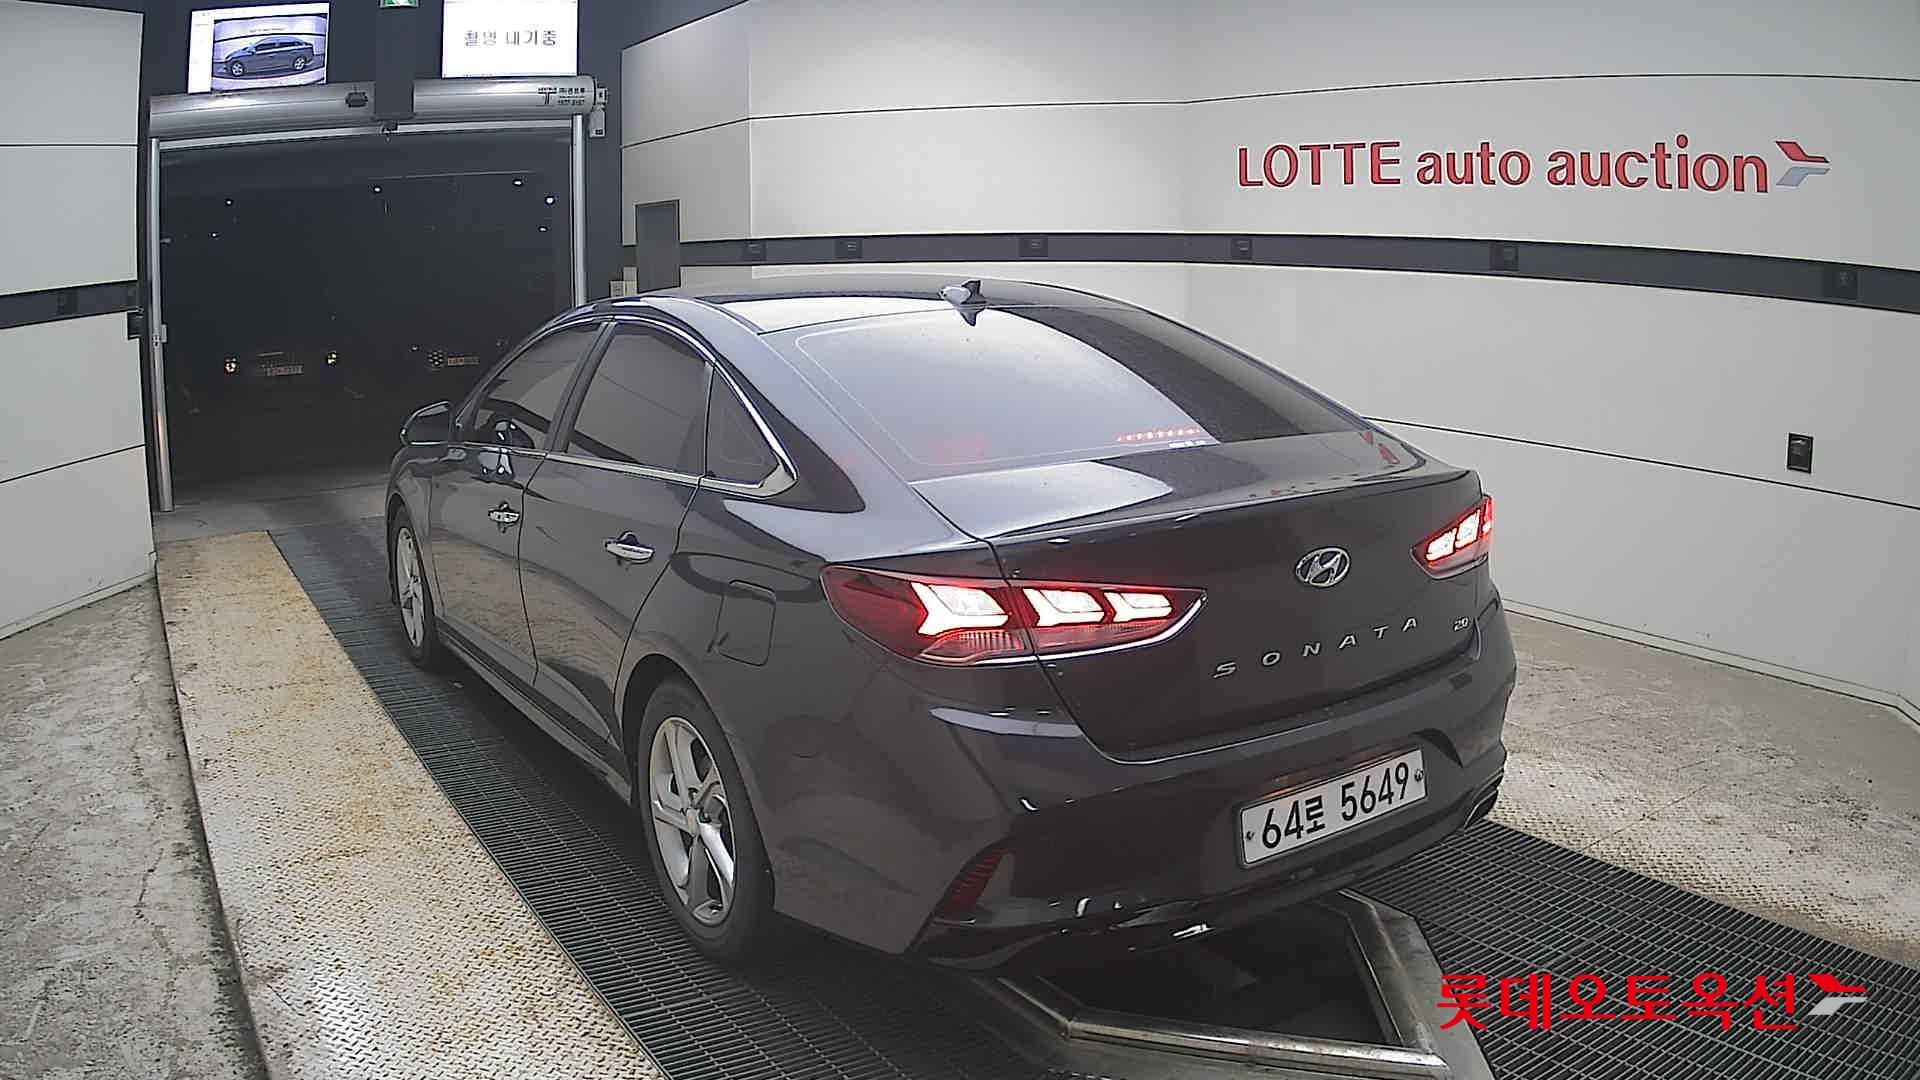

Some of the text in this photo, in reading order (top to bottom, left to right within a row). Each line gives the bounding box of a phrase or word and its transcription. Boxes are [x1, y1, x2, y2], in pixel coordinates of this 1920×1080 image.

[1238, 134, 1769, 194] LOTTE auto auction
[1213, 616, 1419, 680] SONATA
[1261, 761, 1410, 850] 64로 5649
